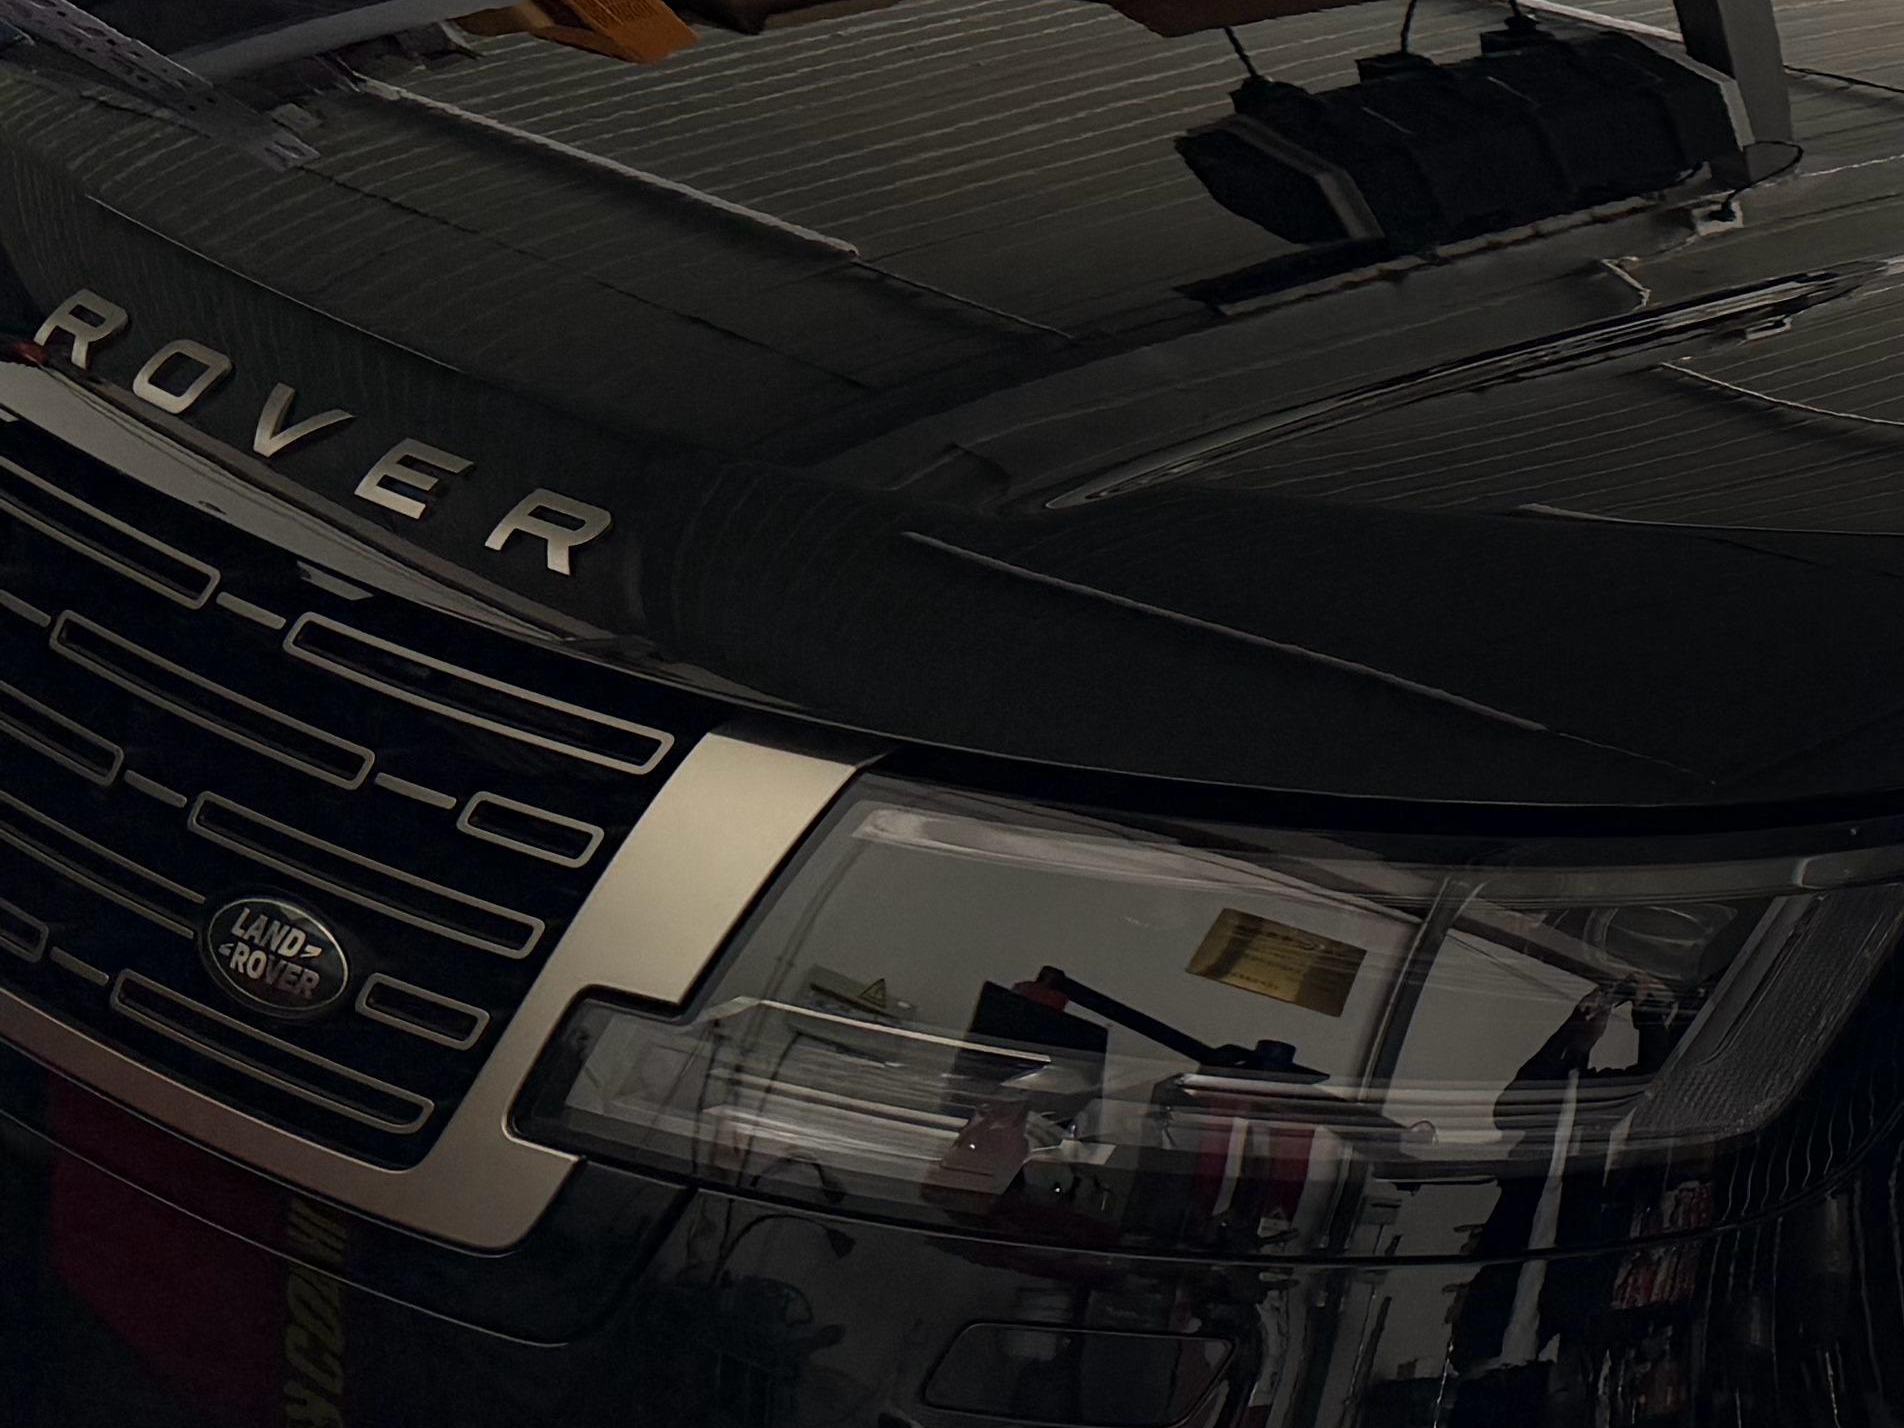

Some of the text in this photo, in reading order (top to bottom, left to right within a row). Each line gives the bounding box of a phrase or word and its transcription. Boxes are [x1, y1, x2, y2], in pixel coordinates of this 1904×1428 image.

[34, 288, 614, 575] ROVER
[231, 907, 307, 958] LAND
[229, 941, 320, 1000] ROVER
